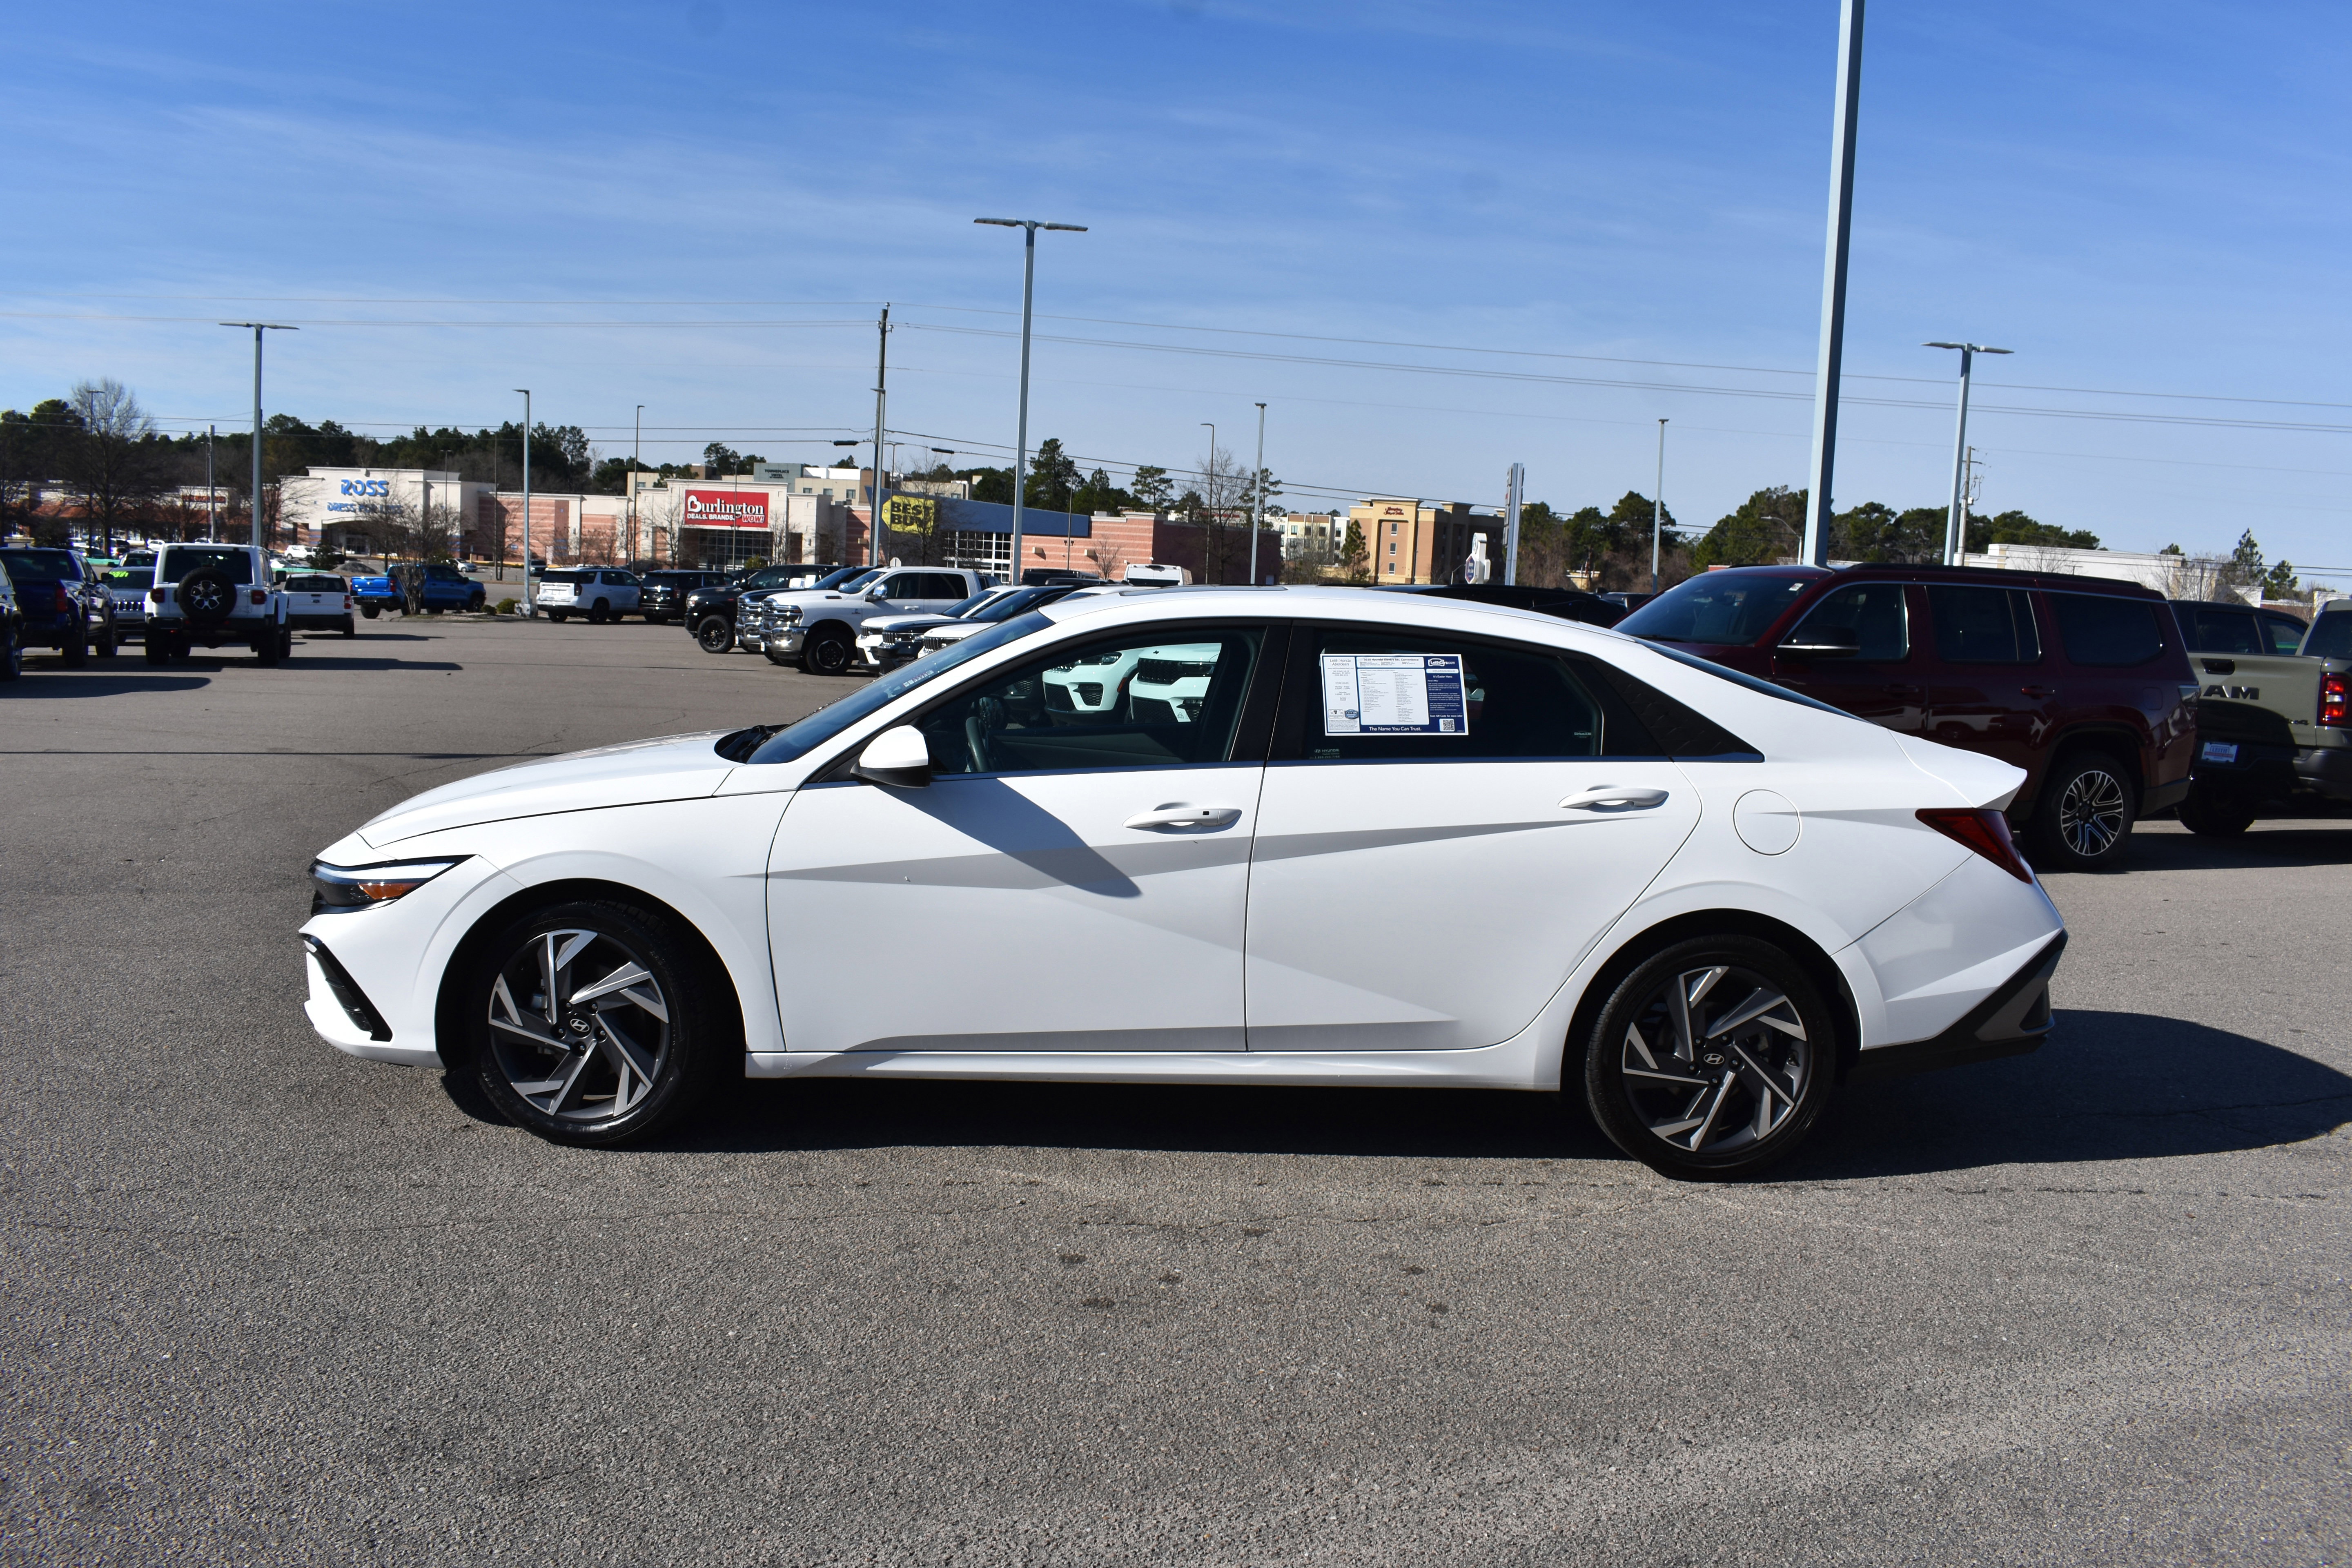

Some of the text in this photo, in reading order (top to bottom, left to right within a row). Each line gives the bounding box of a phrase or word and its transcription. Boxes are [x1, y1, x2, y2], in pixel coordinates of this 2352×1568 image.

[341, 479, 389, 497] ROSS
[327, 502, 356, 512] DRESS
[687, 495, 764, 518] Burlington
[891, 501, 933, 516] BEST
[742, 515, 765, 523] WOW!
[2203, 685, 2260, 700] AM
